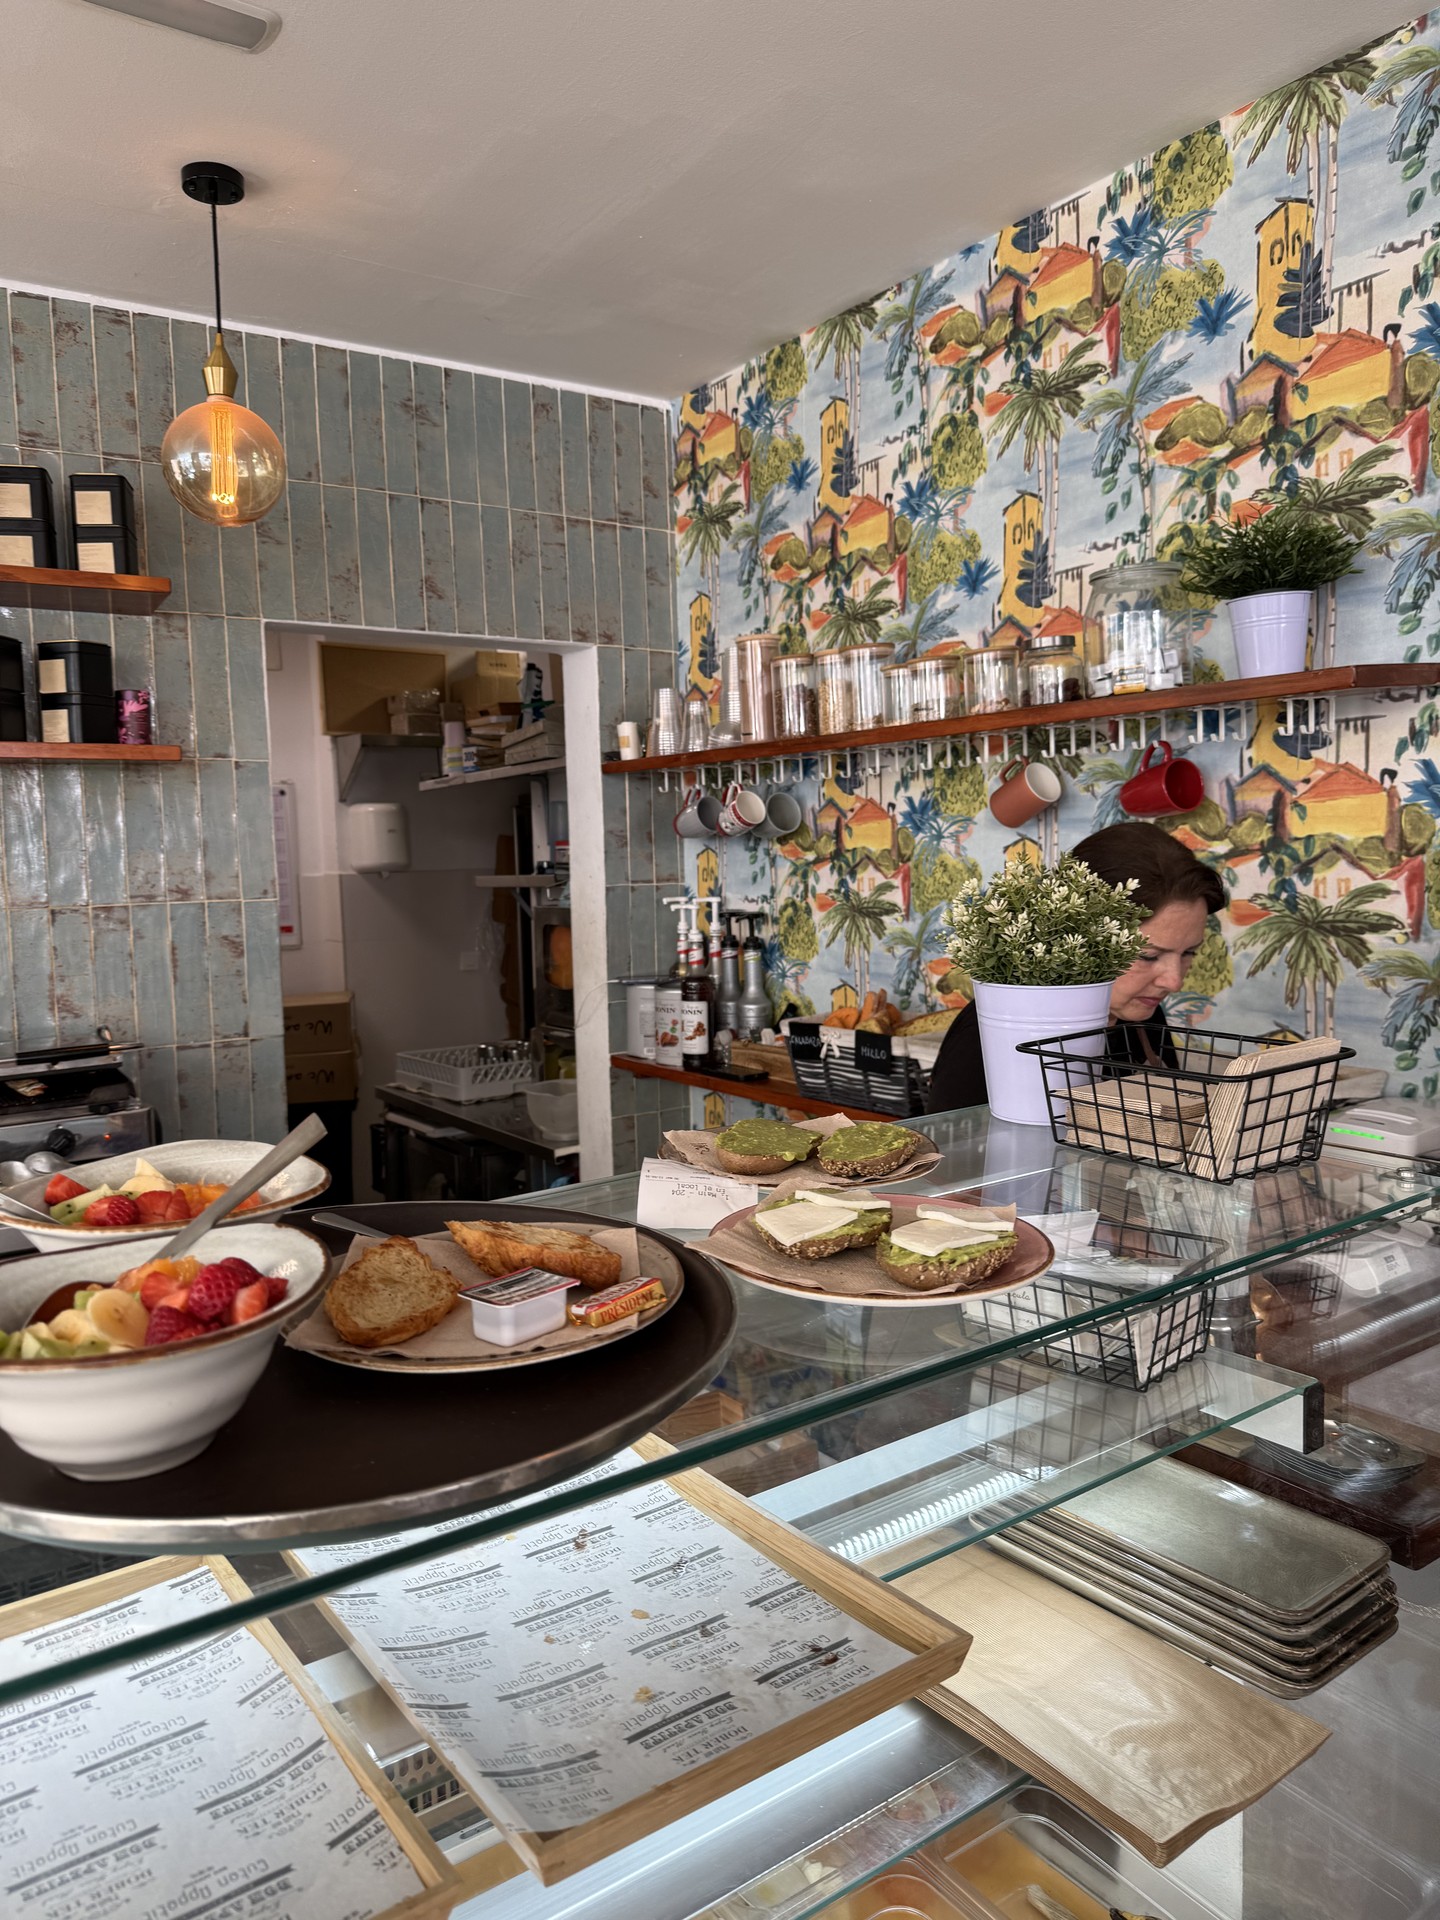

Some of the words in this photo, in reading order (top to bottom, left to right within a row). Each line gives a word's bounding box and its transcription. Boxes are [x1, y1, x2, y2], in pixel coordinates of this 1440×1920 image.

[695, 1570, 733, 1590] DOBER
[415, 1580, 471, 1599] APETITE
[466, 1588, 506, 1602] DOBER
[670, 1587, 695, 1598] TEK
[438, 1601, 462, 1610] TEK
[525, 1608, 581, 1633] APETITE
[578, 1614, 619, 1633] DOBER
[392, 1646, 455, 1660] APETITE
[698, 1641, 739, 1661] DOBER
[447, 1658, 492, 1672] DOBER
[671, 1659, 697, 1671] TEK
[829, 1665, 869, 1688] DOBER
[802, 1685, 828, 1699] TEK
[569, 1693, 615, 1715] DOBER
[538, 1713, 566, 1724] TEK
[640, 1715, 702, 1750] APETITE
[702, 1725, 748, 1749] DOBER
[671, 1748, 700, 1764] TEK
